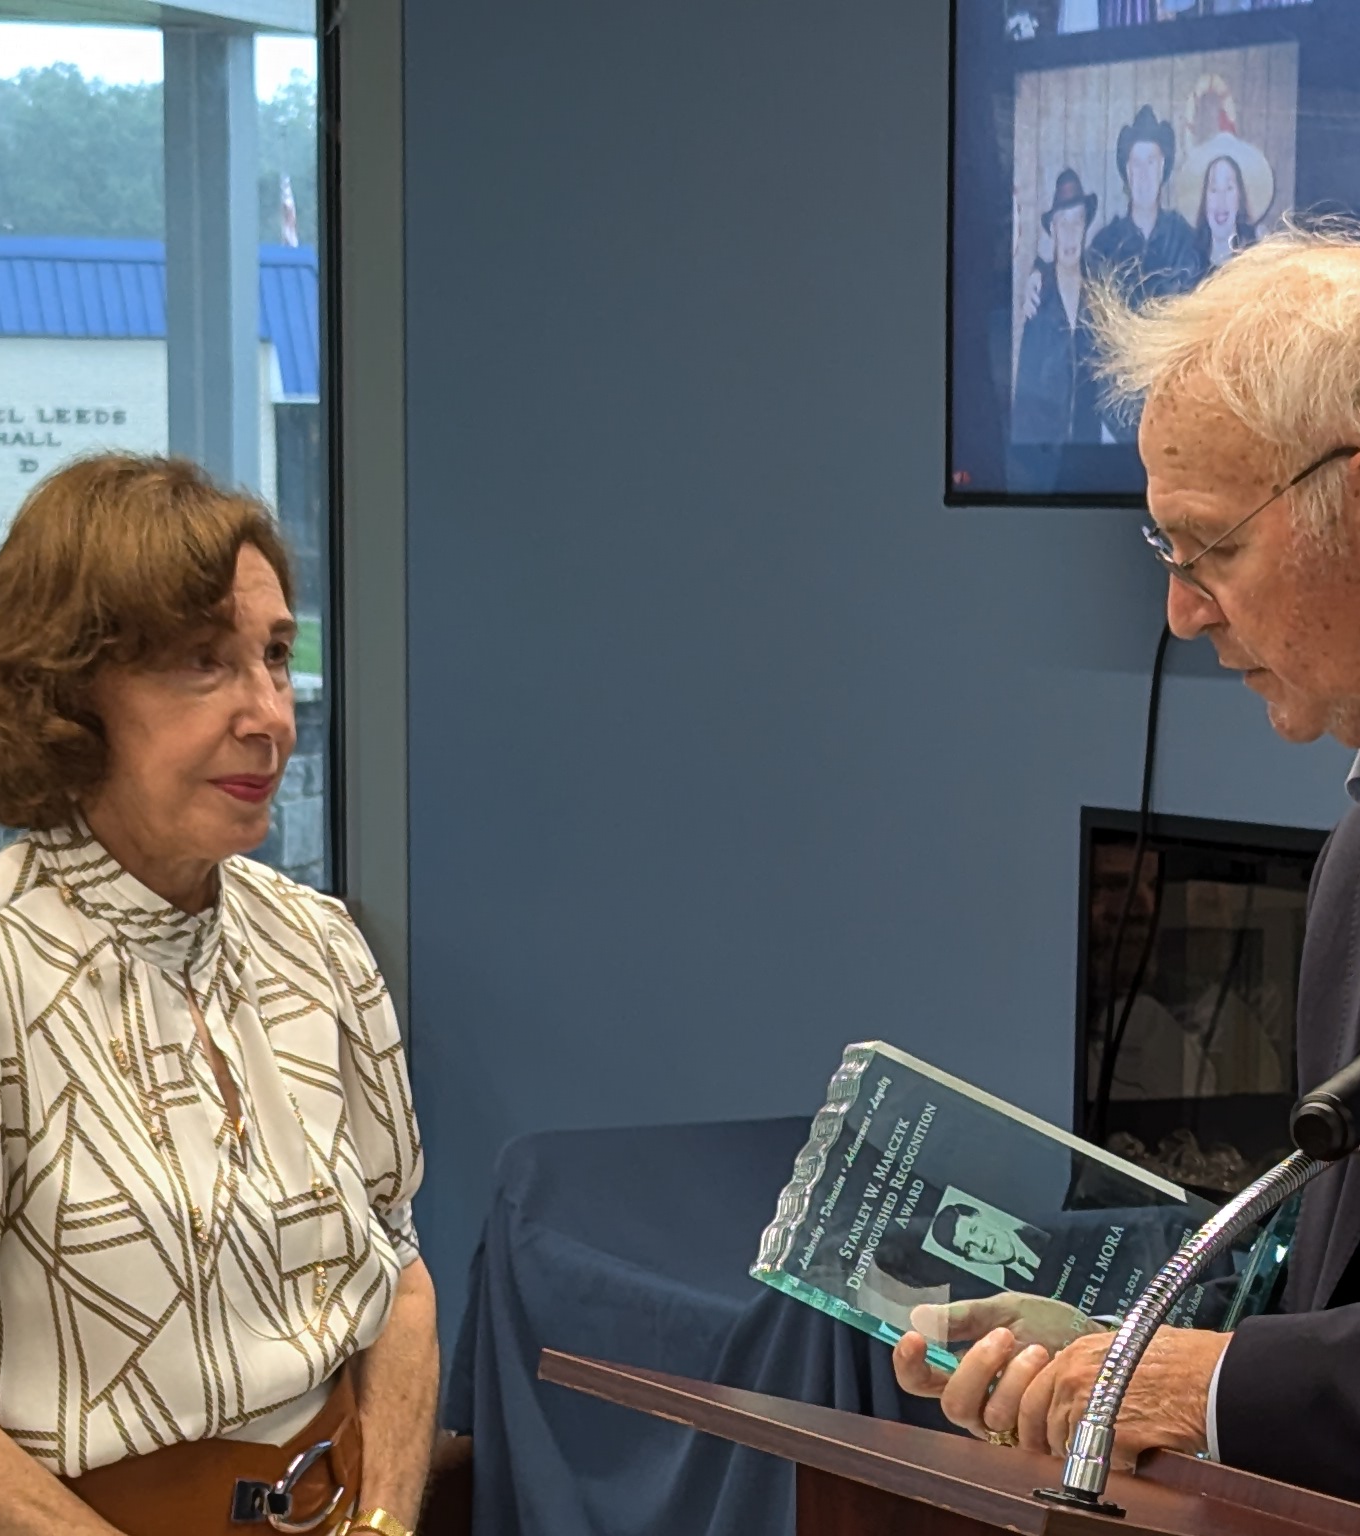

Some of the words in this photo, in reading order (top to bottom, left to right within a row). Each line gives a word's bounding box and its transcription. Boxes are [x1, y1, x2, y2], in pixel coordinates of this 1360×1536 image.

[37, 408, 127, 425] LEEDS
[19, 458, 39, 473] D
[872, 1117, 910, 1181] MARCZYK
[799, 1225, 825, 1271] Leadership
[820, 1174, 846, 1217] Dedication
[844, 1116, 872, 1168] Achievement
[869, 1076, 892, 1110] Loyalty
[863, 1182, 883, 1199] W.
[846, 1191, 899, 1290] DISTINGUISHED
[889, 1102, 938, 1190] RECOGNITION
[895, 1179, 925, 1229] AWARD
[839, 1202, 874, 1259] STANLEY
[1066, 1254, 1076, 1265] to
[1071, 1284, 1101, 1332] PETER
[1095, 1225, 1125, 1272] MORA
[1125, 1268, 1144, 1296] 2024
[1186, 1283, 1205, 1316] School
